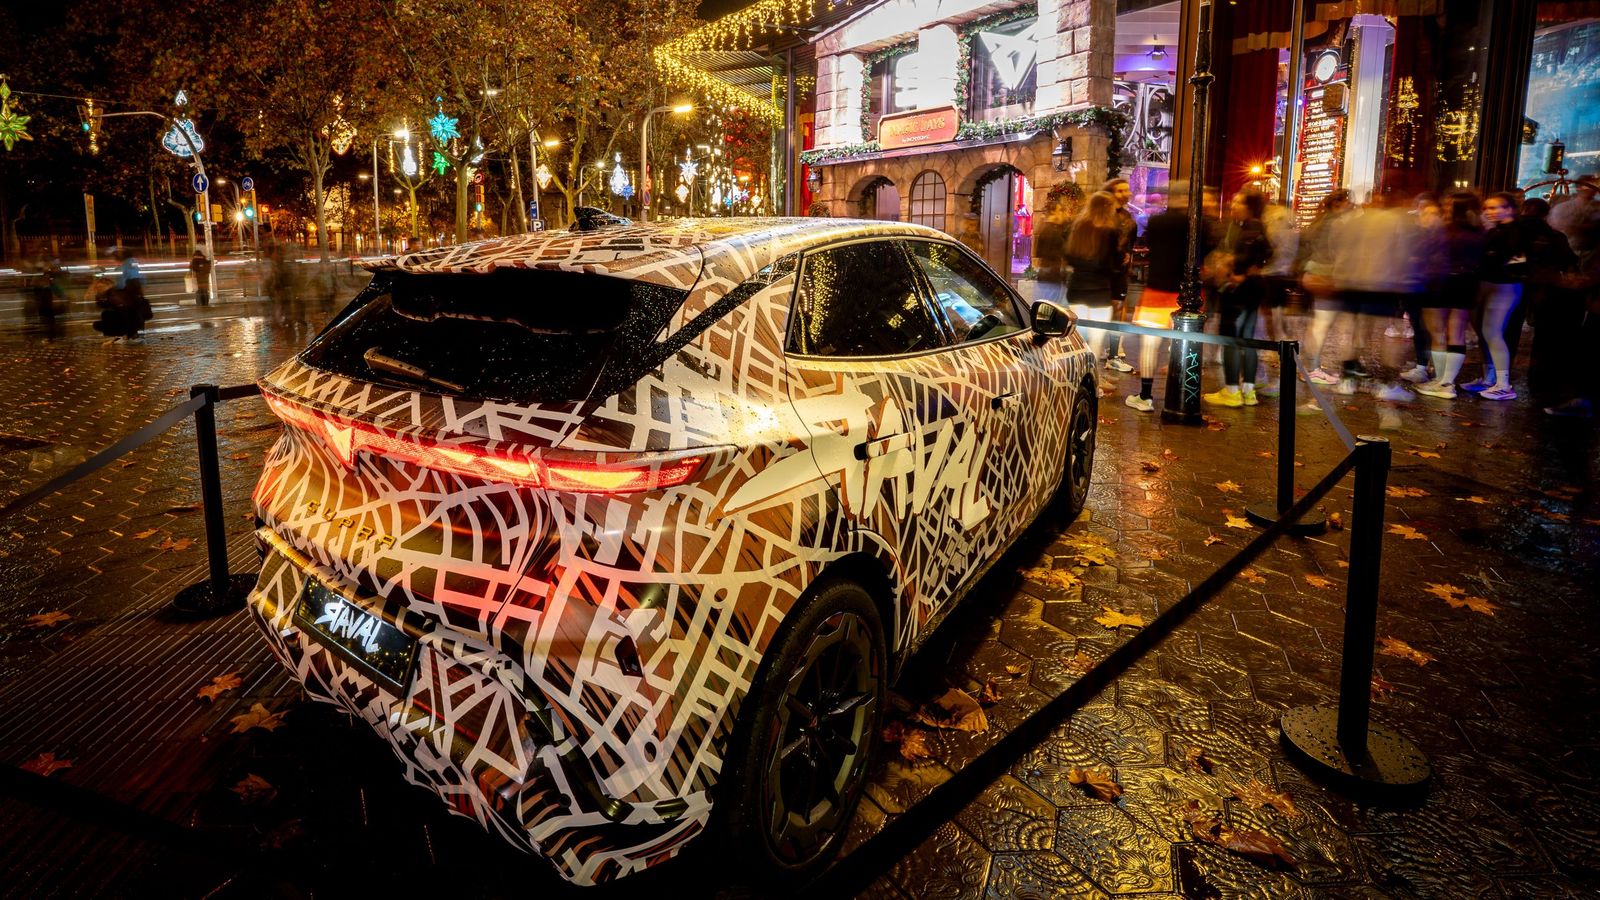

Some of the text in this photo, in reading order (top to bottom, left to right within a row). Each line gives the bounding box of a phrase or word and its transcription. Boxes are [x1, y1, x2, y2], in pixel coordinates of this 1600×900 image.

[533, 221, 542, 231] P
[307, 499, 397, 549] CUPRA
[314, 599, 380, 653] RAVAL
